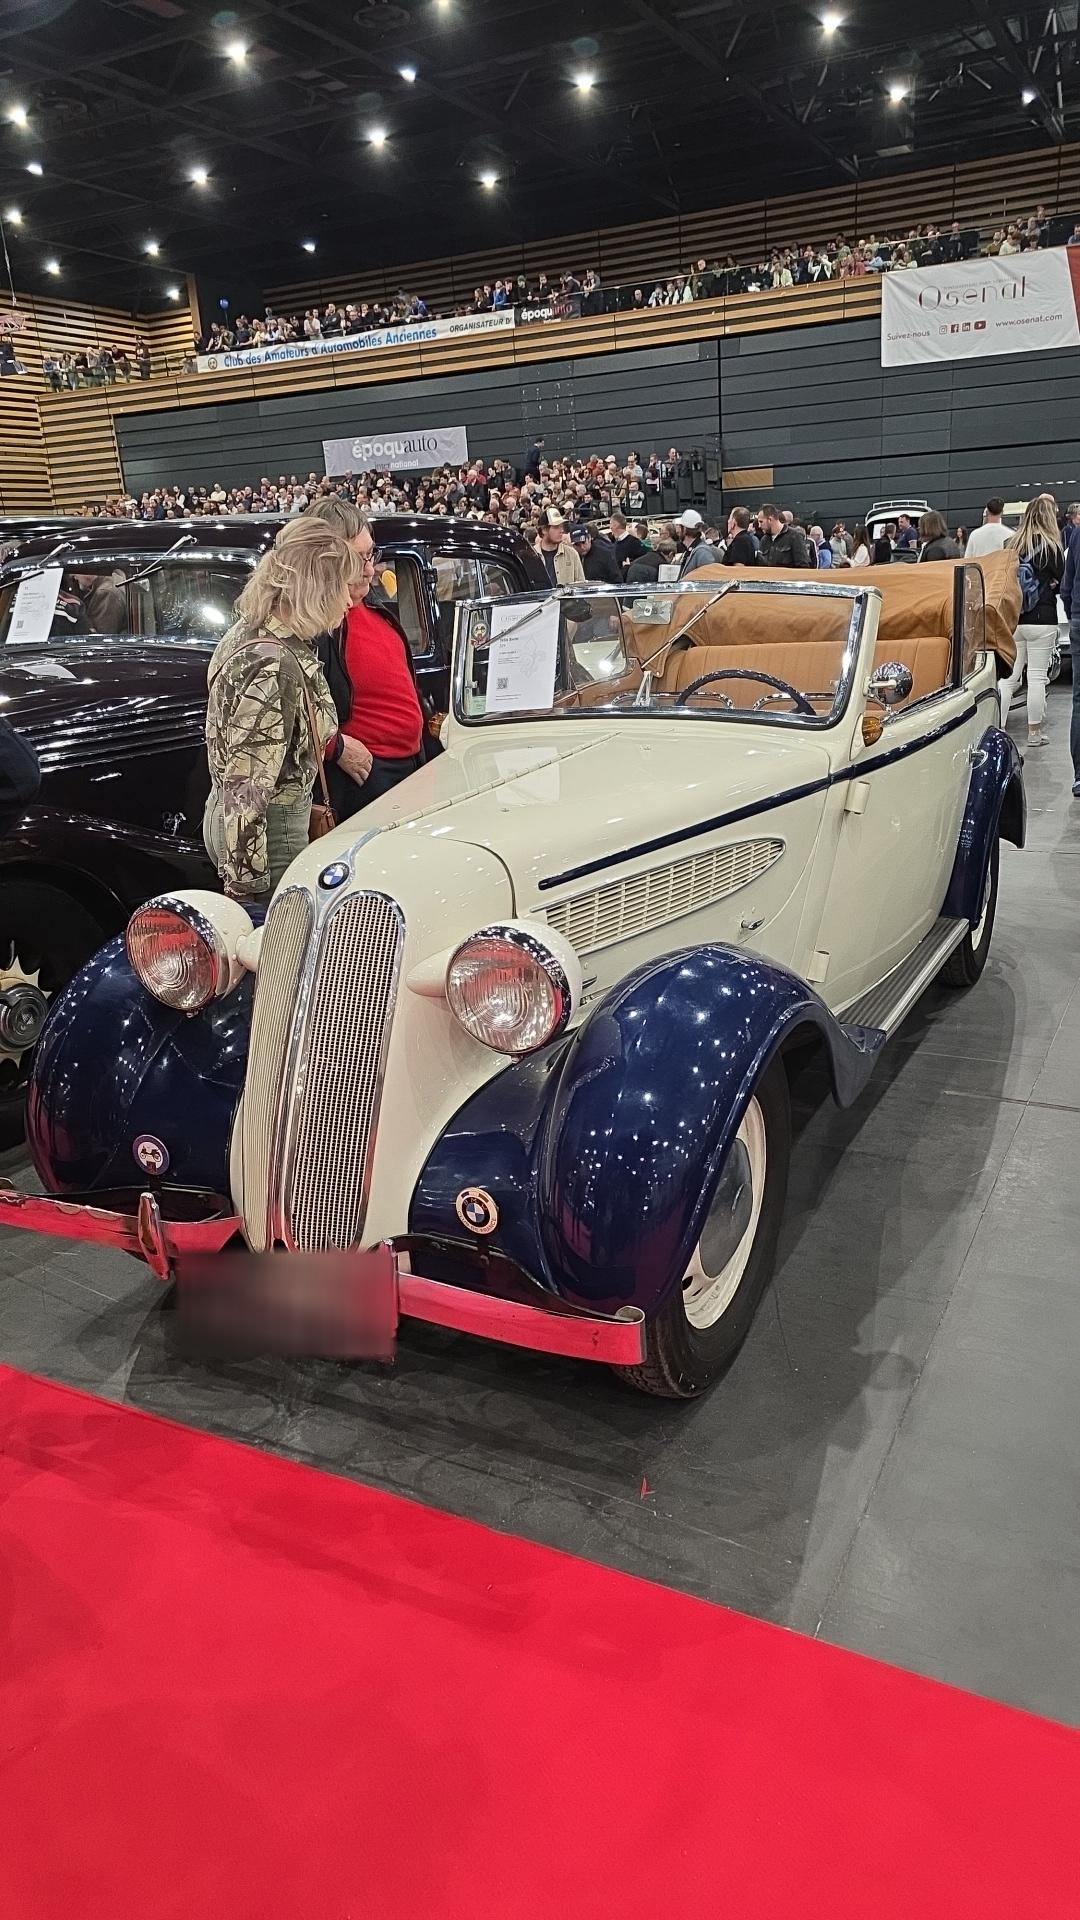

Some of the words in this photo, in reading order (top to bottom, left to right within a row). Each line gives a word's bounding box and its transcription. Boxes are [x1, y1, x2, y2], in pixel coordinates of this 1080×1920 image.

[449, 318, 504, 333] ORGANISATEUR
[887, 329, 930, 341] Suivez-nous
[995, 313, 1062, 328] www.osenat.com
[224, 354, 244, 367] Club
[246, 353, 261, 364] des
[264, 345, 309, 362] Amateurs
[385, 328, 437, 345] Anciennes
[351, 434, 438, 462] époquauto
